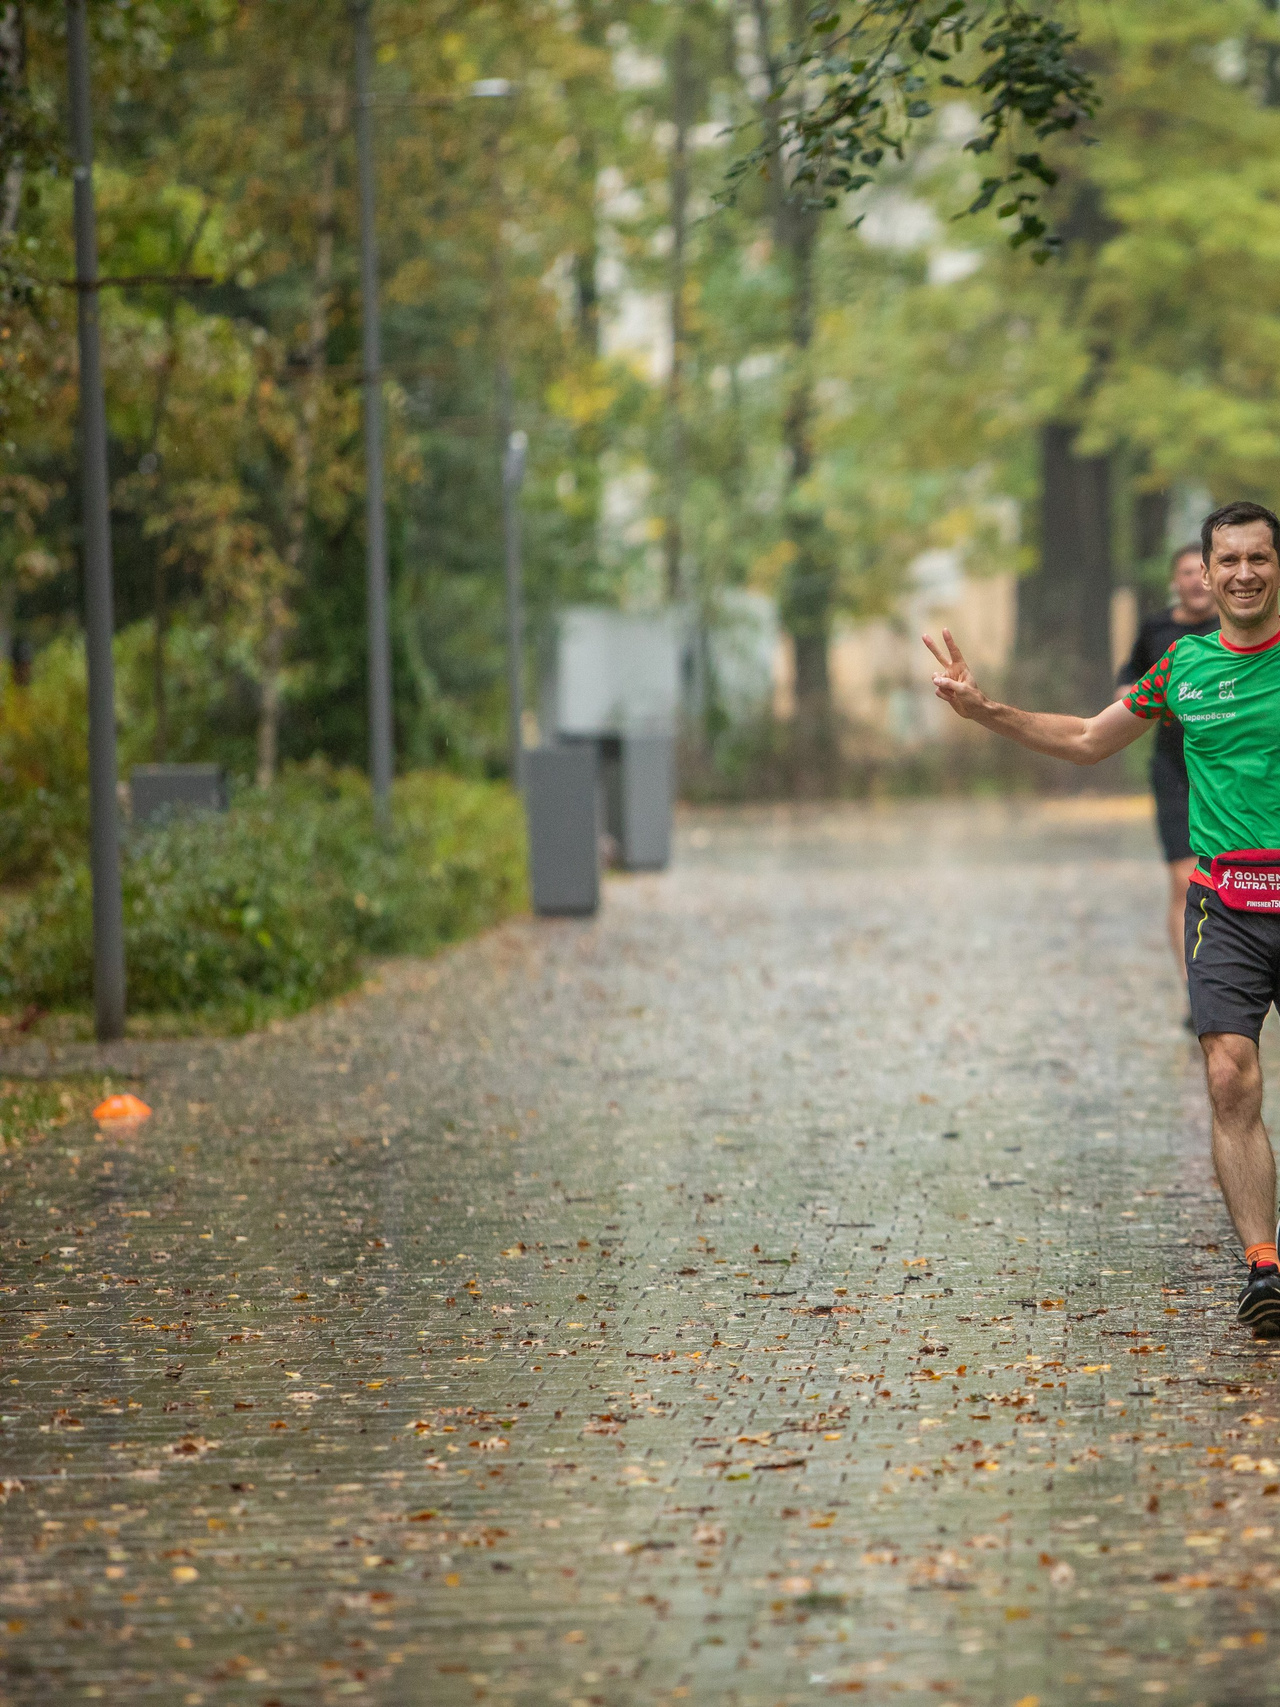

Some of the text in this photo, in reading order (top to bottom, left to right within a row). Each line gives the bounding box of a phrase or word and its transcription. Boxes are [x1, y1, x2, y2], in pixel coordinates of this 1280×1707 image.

[1218, 690, 1235, 700] CA
[1183, 712, 1236, 722] Перекрёсток
[1233, 881, 1267, 890] ULTRA
